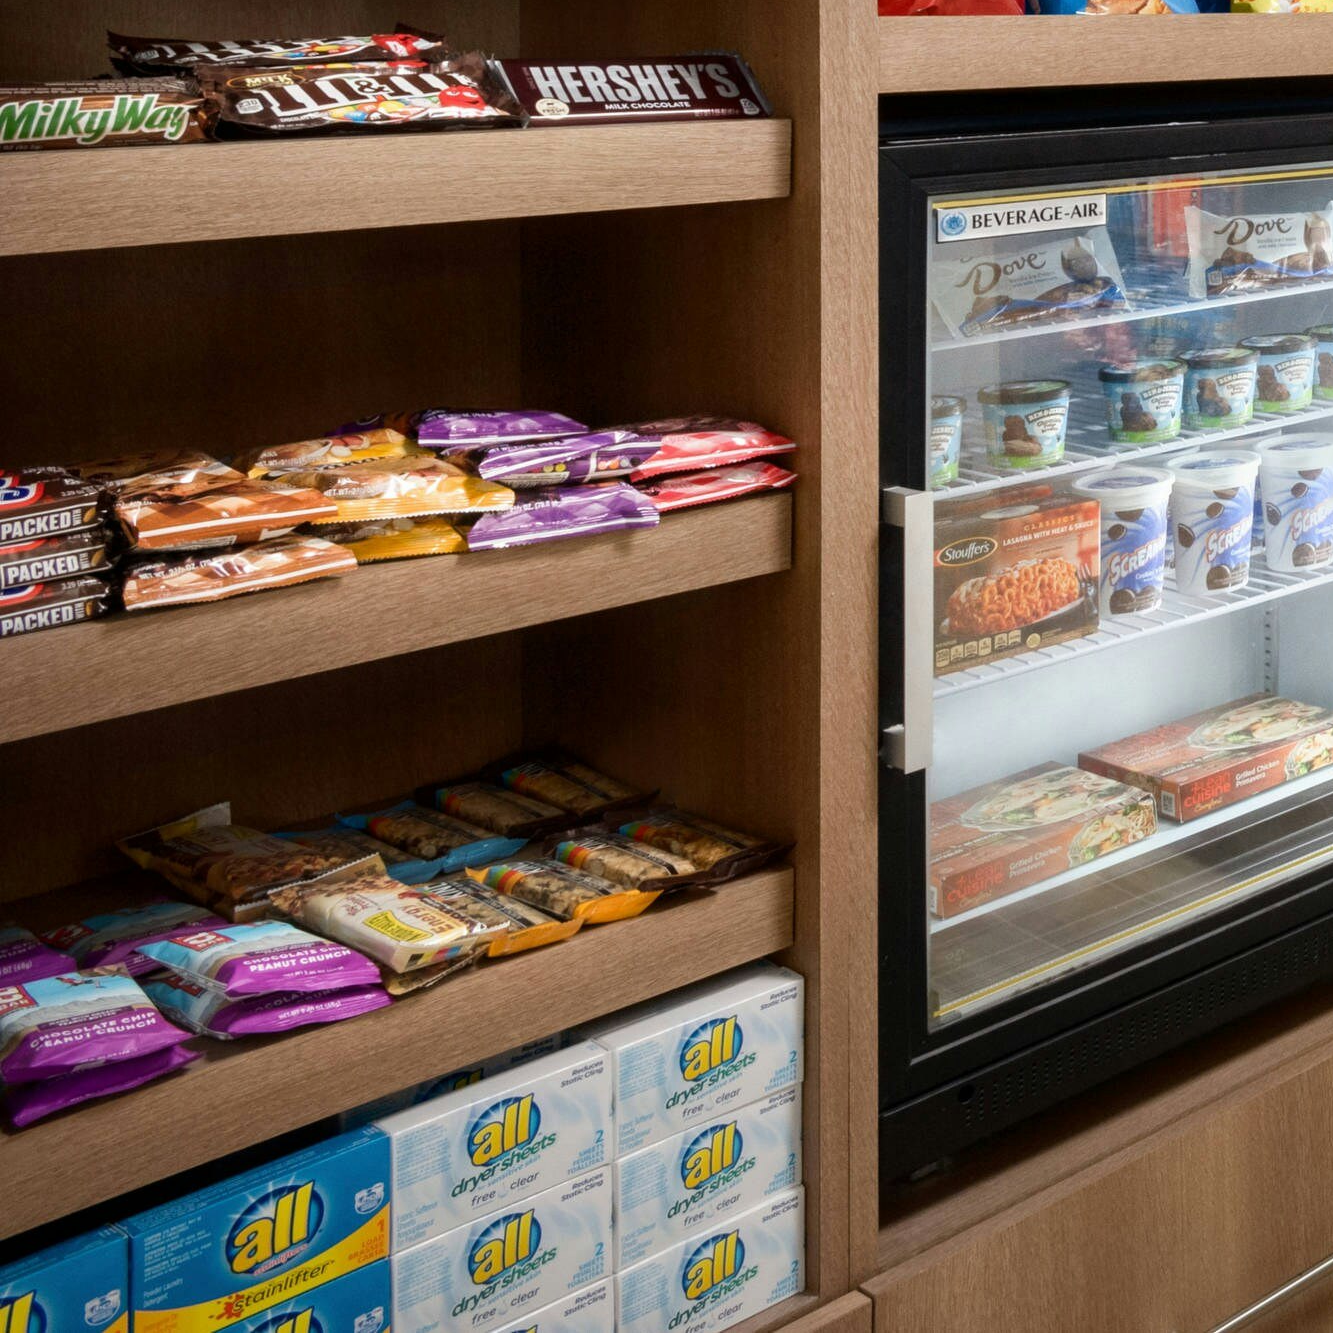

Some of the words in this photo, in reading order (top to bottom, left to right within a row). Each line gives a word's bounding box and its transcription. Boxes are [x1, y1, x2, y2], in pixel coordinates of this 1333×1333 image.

[529, 64, 741, 105] HERSHEY'S
[0, 97, 113, 144] Milky
[605, 102, 630, 110] MILK
[631, 100, 691, 110] CHOCOLATE
[972, 203, 1098, 229] BEVERAGE-AIR
[1, 510, 71, 540] PACKED
[1003, 535, 1032, 547] LASAGNA
[1033, 531, 1050, 540] WITH
[1051, 526, 1068, 536] MEAT
[1075, 520, 1094, 530] SAUCE
[1024, 515, 1076, 532] CLASSICS
[944, 541, 991, 561] Stouffer's
[7, 555, 78, 584] PACKED
[1, 605, 73, 635] PACKED
[1236, 768, 1256, 781] Grilled
[1257, 759, 1280, 775] Chicken
[249, 958, 296, 972] PEANUT
[300, 949, 351, 965] CRUNCH
[95, 1019, 157, 1034] CRUNCH
[123, 1011, 156, 1024] CHIP
[683, 1015, 738, 1081] all
[666, 1081, 707, 1109] dryer
[708, 1052, 756, 1086] sheets
[683, 1102, 703, 1117] free
[715, 1088, 742, 1105] clear
[472, 1093, 534, 1166] all
[451, 1165, 501, 1198] dryer
[500, 1133, 556, 1171] sheets
[685, 1120, 738, 1190] all
[472, 1190, 496, 1207] free
[510, 1172, 540, 1190] clear
[667, 1188, 707, 1219] dryer
[708, 1156, 756, 1192] sheets
[684, 1211, 705, 1227] free
[716, 1193, 741, 1211] clear
[231, 1180, 315, 1274] all
[473, 1208, 534, 1285] all
[232, 1261, 330, 1312] stainlifter
